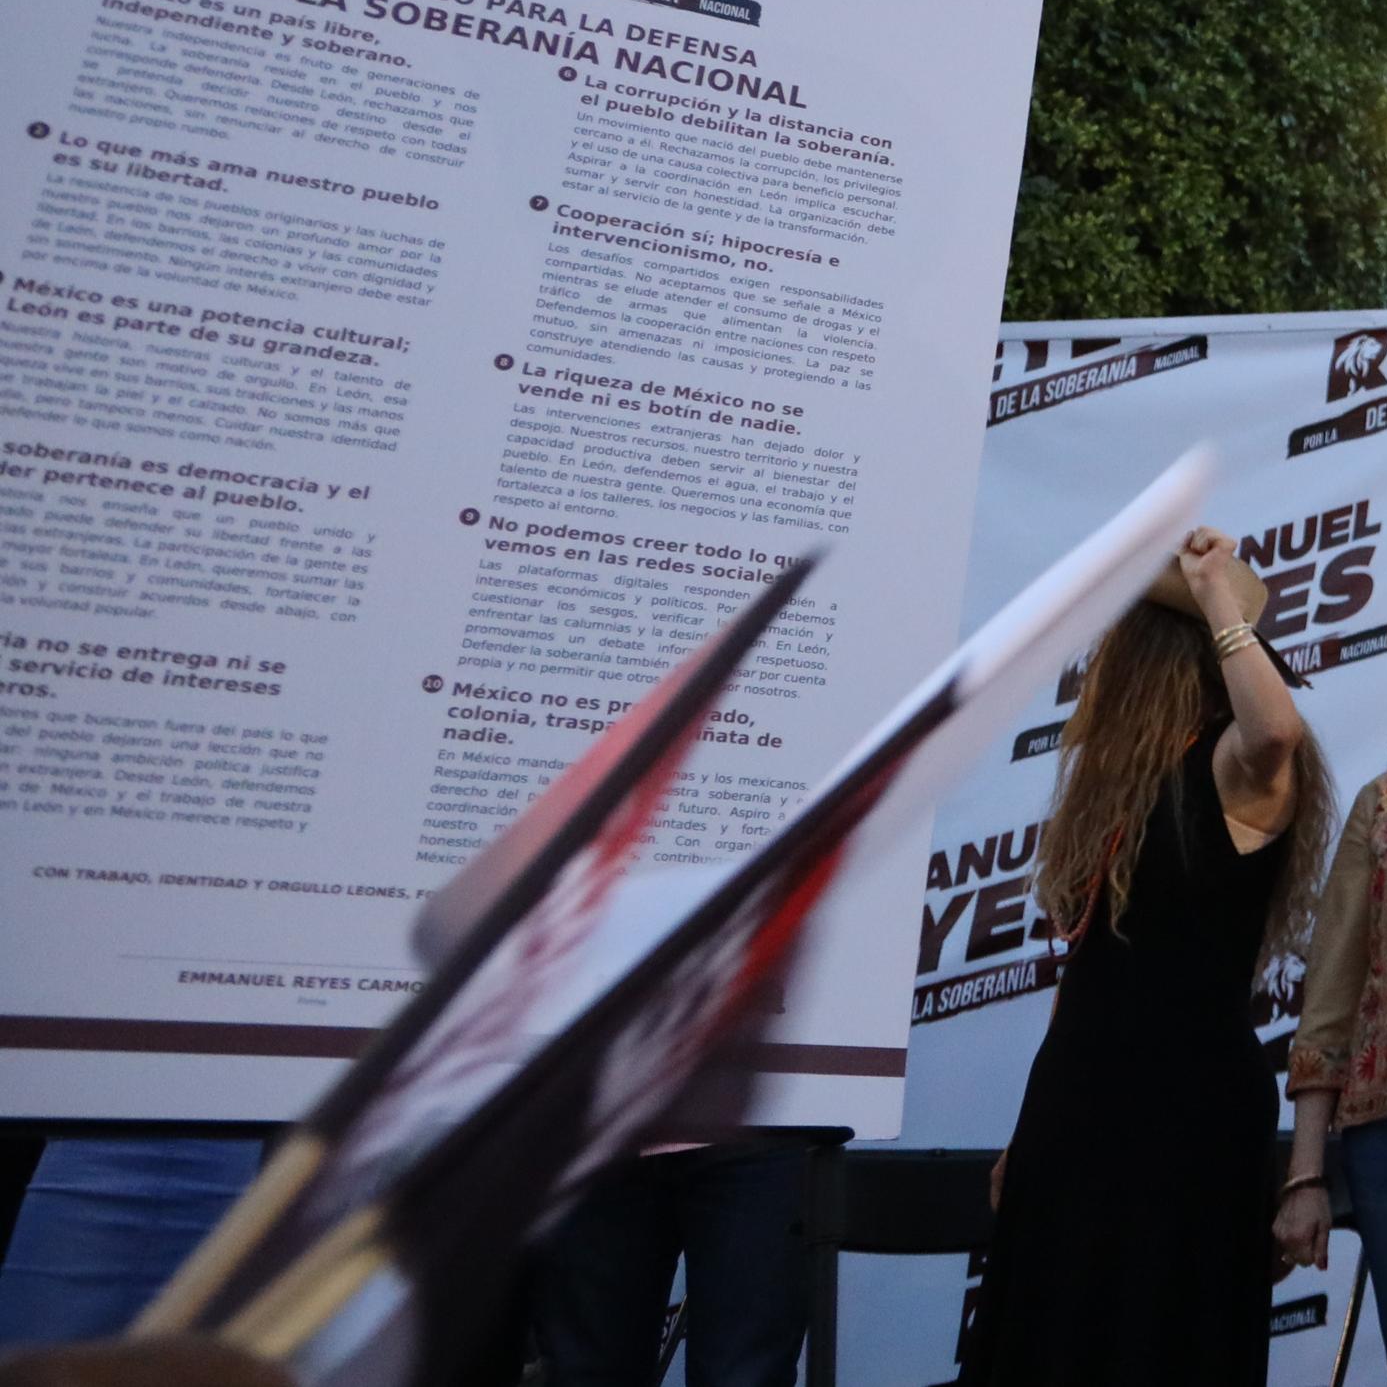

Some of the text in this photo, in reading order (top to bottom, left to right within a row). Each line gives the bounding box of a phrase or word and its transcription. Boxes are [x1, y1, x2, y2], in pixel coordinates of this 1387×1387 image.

[578, 13, 613, 36] LA
[626, 24, 756, 66] DEFENSA
[615, 48, 804, 106] NACIONAL
[580, 94, 893, 165] el pueblo debilitan la soberanía.
[584, 74, 891, 149] La corrupción y la distancia con
[553, 222, 773, 272] intervencionismo, no.
[557, 204, 839, 267] Cooperación sí; hipocresía e
[522, 362, 803, 417] La riqueza de México no se
[996, 394, 1016, 416] DE
[1020, 387, 1040, 411] LA
[1043, 355, 1138, 402] SOBERANÍA
[1153, 345, 1200, 371] NACIONAL
[518, 383, 800, 434] vende ni es botín de nadie.
[1303, 433, 1323, 452] POR
[1324, 428, 1339, 444] LA
[485, 538, 694, 573] vemos en las redes
[488, 515, 767, 563] No podemos creer todo lo
[1238, 498, 1383, 569] NUEL
[1028, 736, 1047, 754] POR
[938, 963, 1037, 1013] SOBERANÍA
